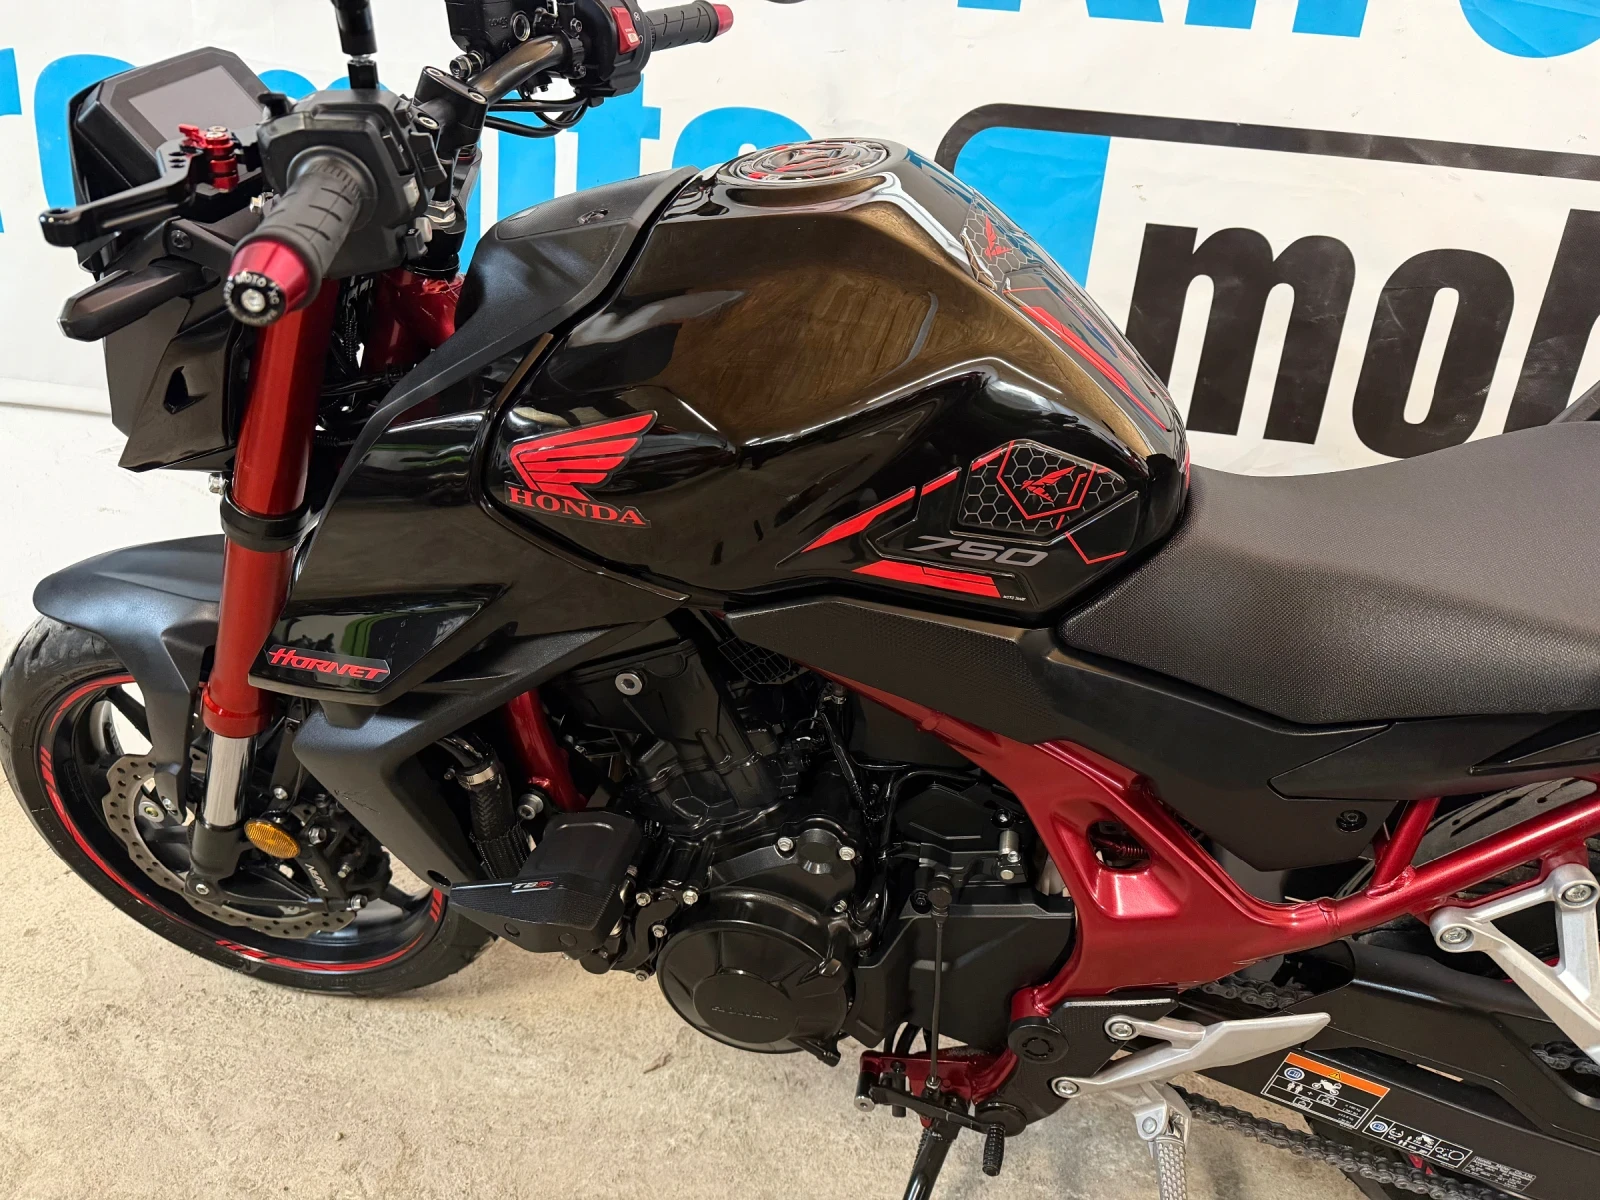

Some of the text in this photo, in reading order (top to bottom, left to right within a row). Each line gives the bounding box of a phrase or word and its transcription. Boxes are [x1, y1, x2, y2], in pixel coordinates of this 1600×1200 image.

[508, 486, 646, 525] HONDA
[905, 535, 1049, 567] 750
[268, 648, 389, 680] HORNET
